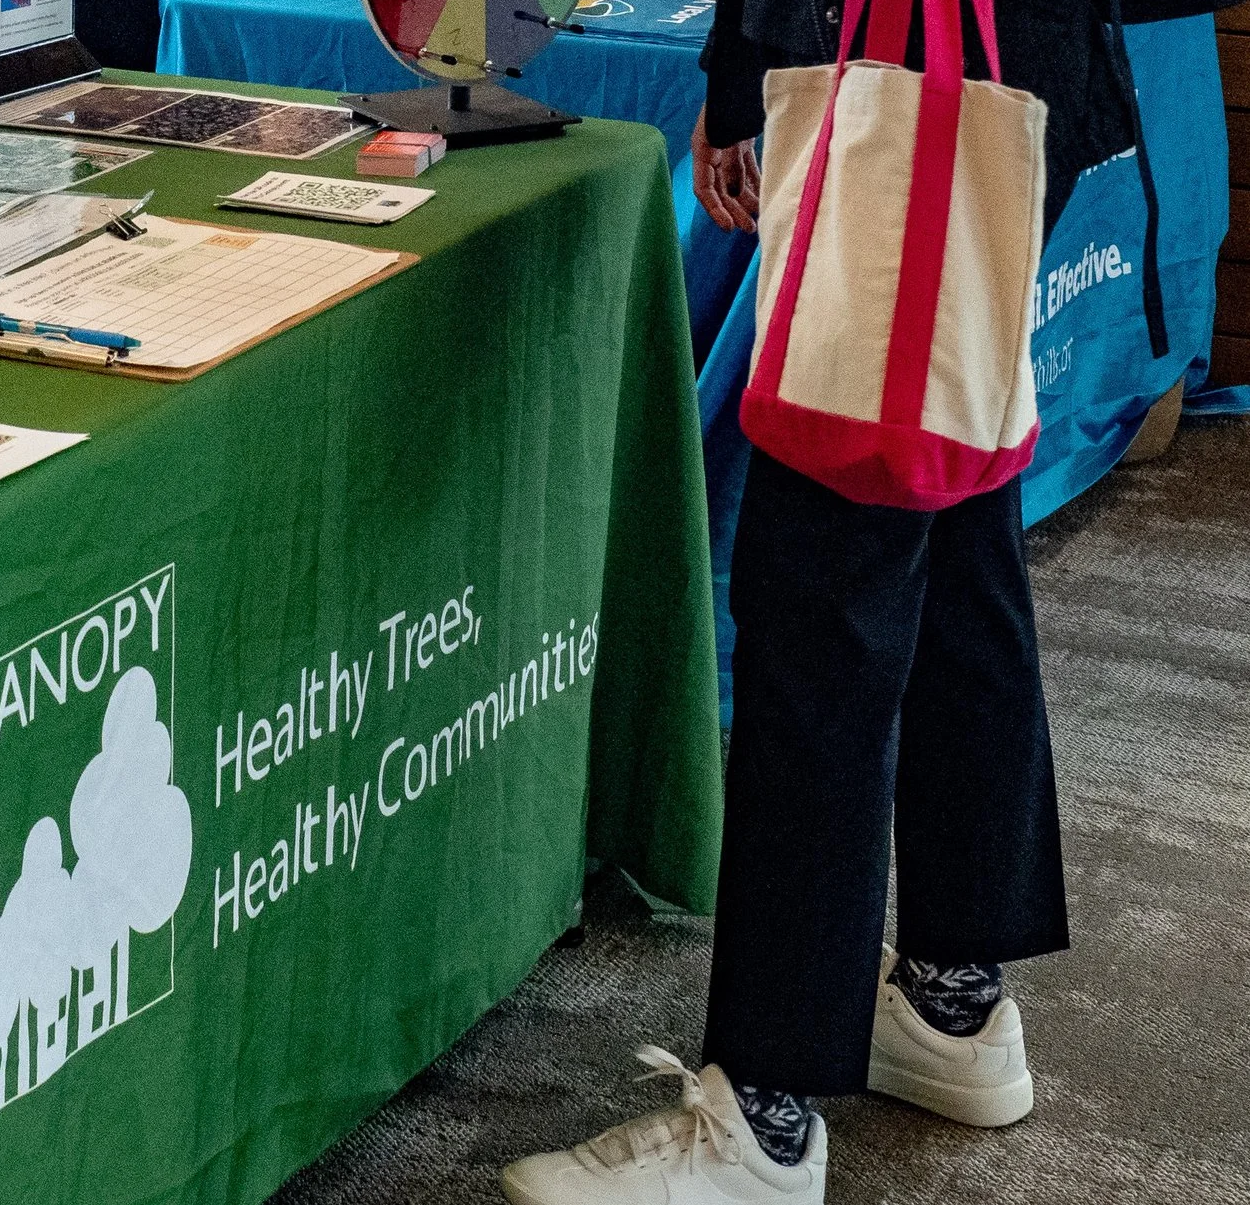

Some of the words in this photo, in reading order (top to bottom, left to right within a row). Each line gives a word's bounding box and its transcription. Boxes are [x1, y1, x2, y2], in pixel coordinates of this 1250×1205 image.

[1048, 241, 1132, 321] Effective.
[213, 781, 370, 948] Healthy
[377, 612, 598, 817] Communities
[215, 650, 373, 808] Healthy
[379, 586, 482, 692] Trees,
